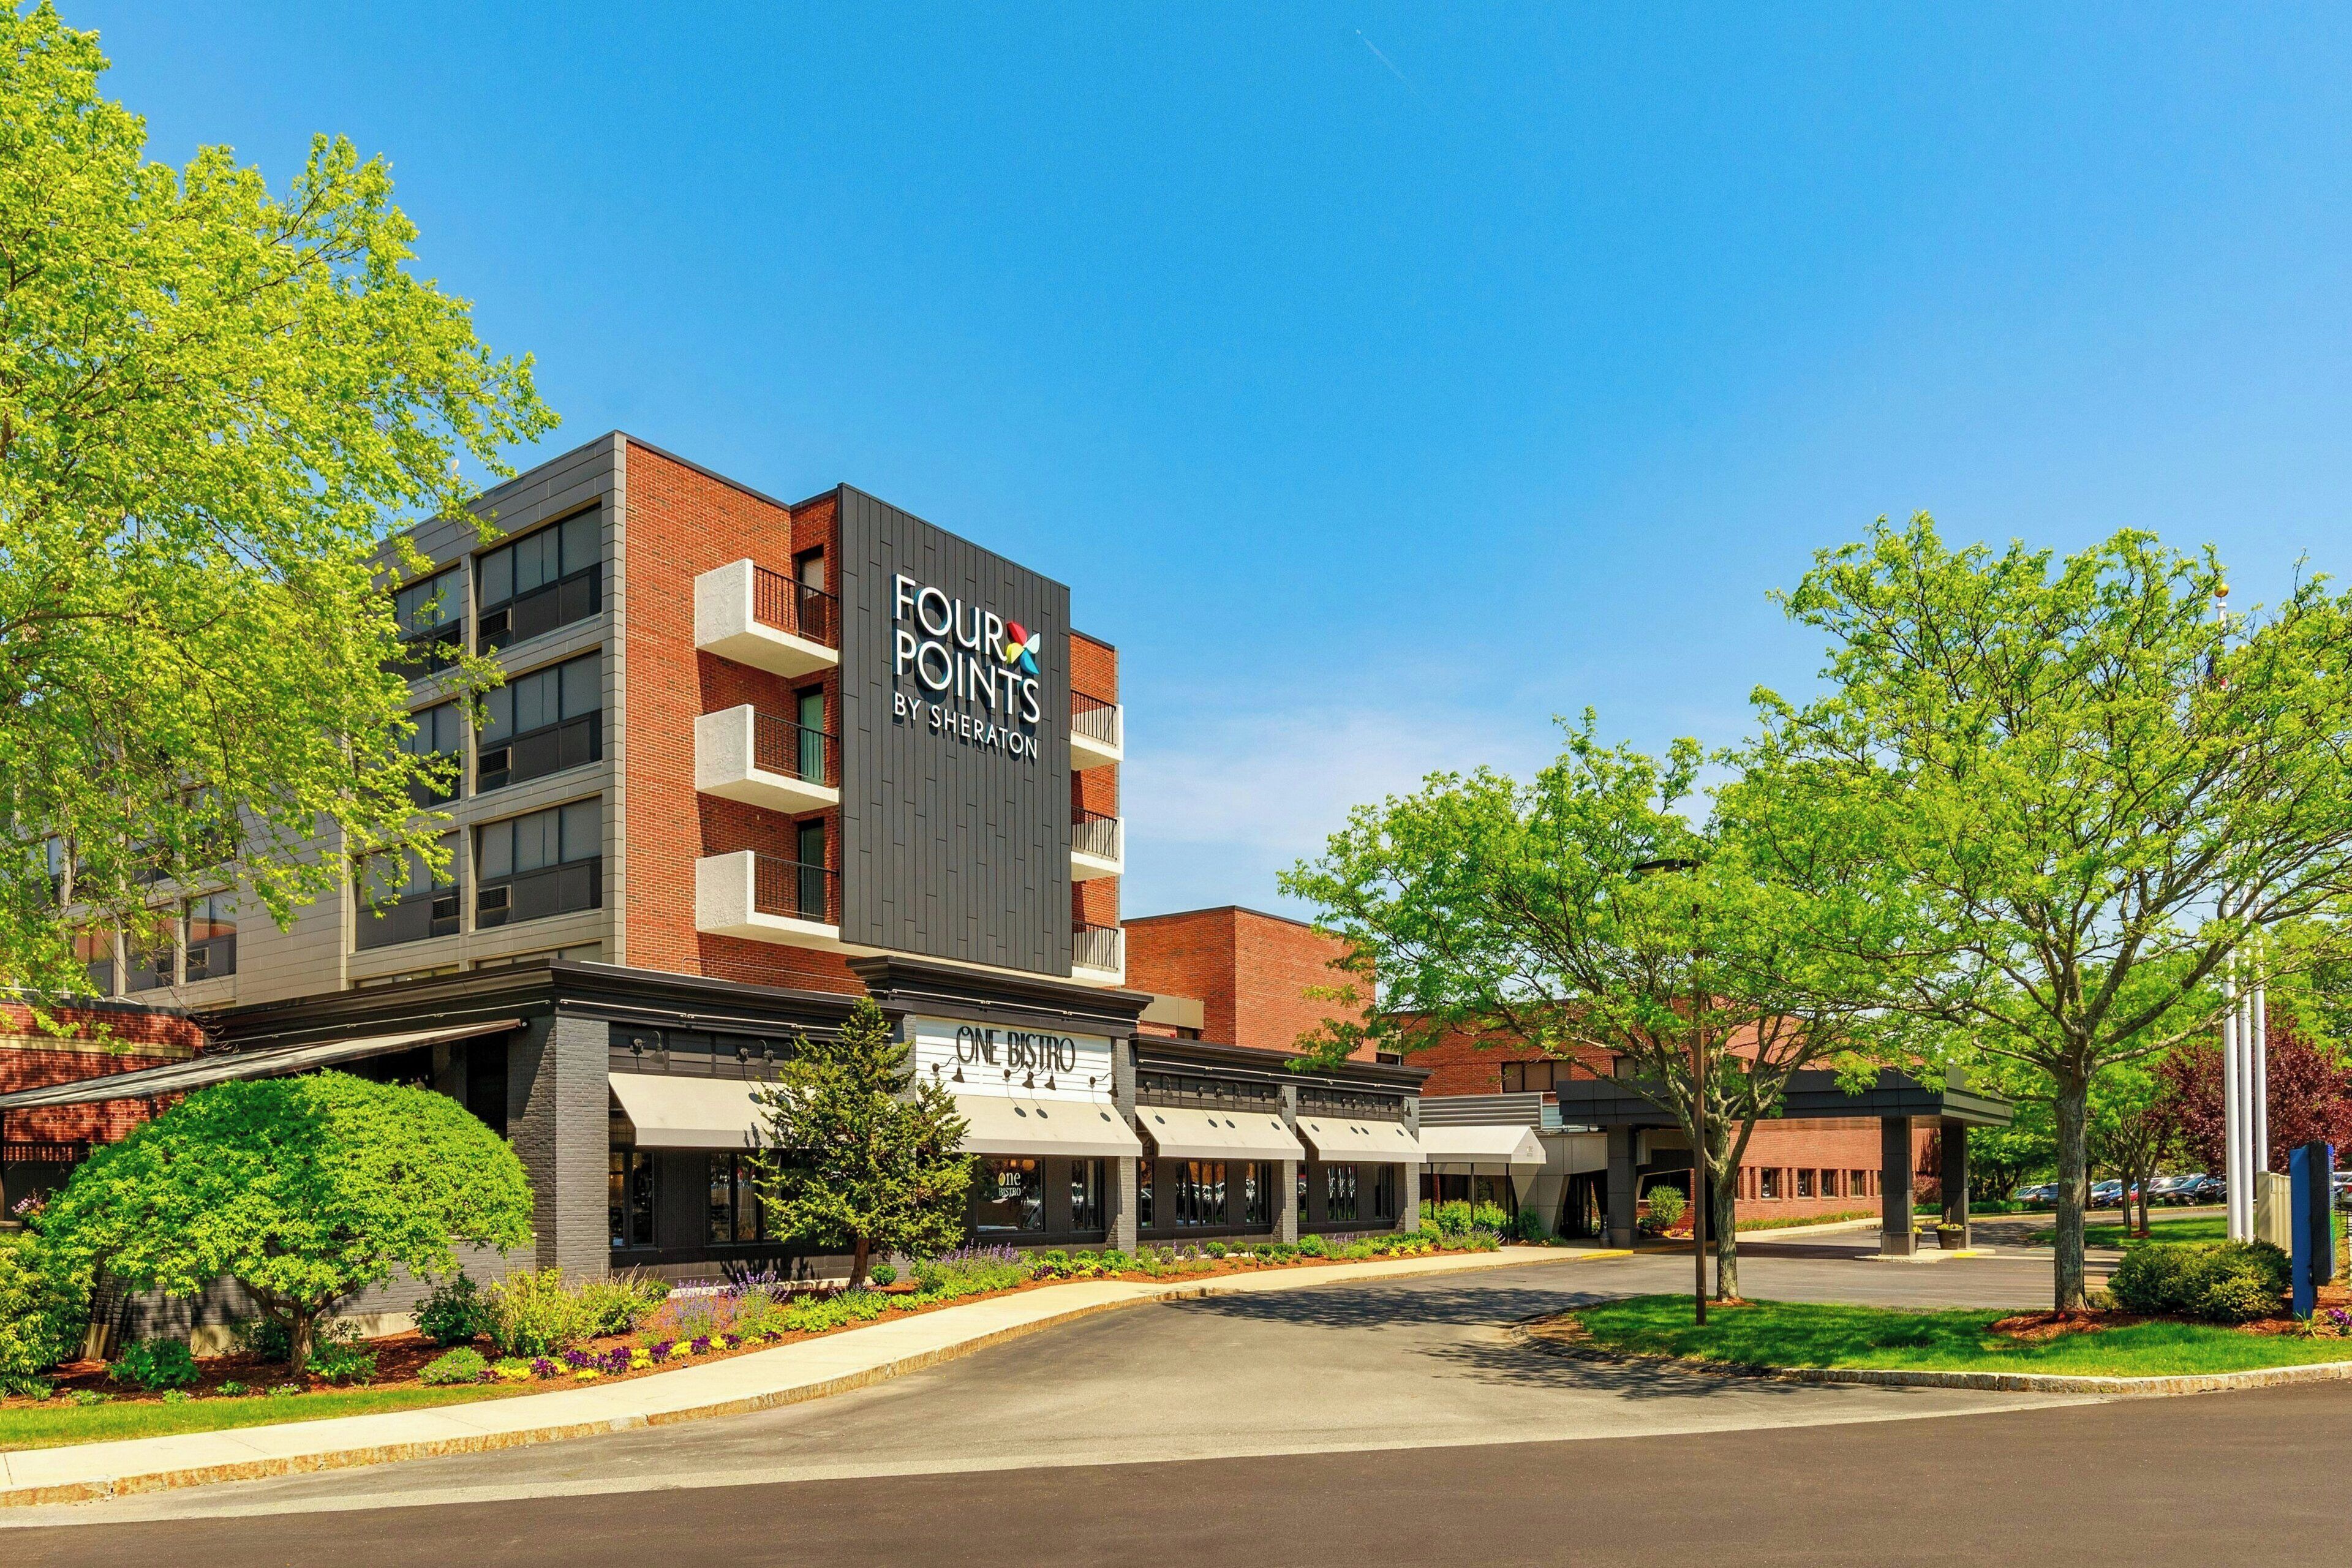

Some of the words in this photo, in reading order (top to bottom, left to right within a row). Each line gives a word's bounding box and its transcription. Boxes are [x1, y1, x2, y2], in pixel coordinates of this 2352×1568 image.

[892, 573, 1008, 662] FOUR
[892, 629, 1040, 723] POINTS
[894, 692, 921, 720] BY
[929, 705, 1037, 760] SHERATON
[956, 1026, 1001, 1065] ONE
[1008, 1031, 1076, 1072] BISTRO
[998, 1187, 1022, 1197] BISTRO
